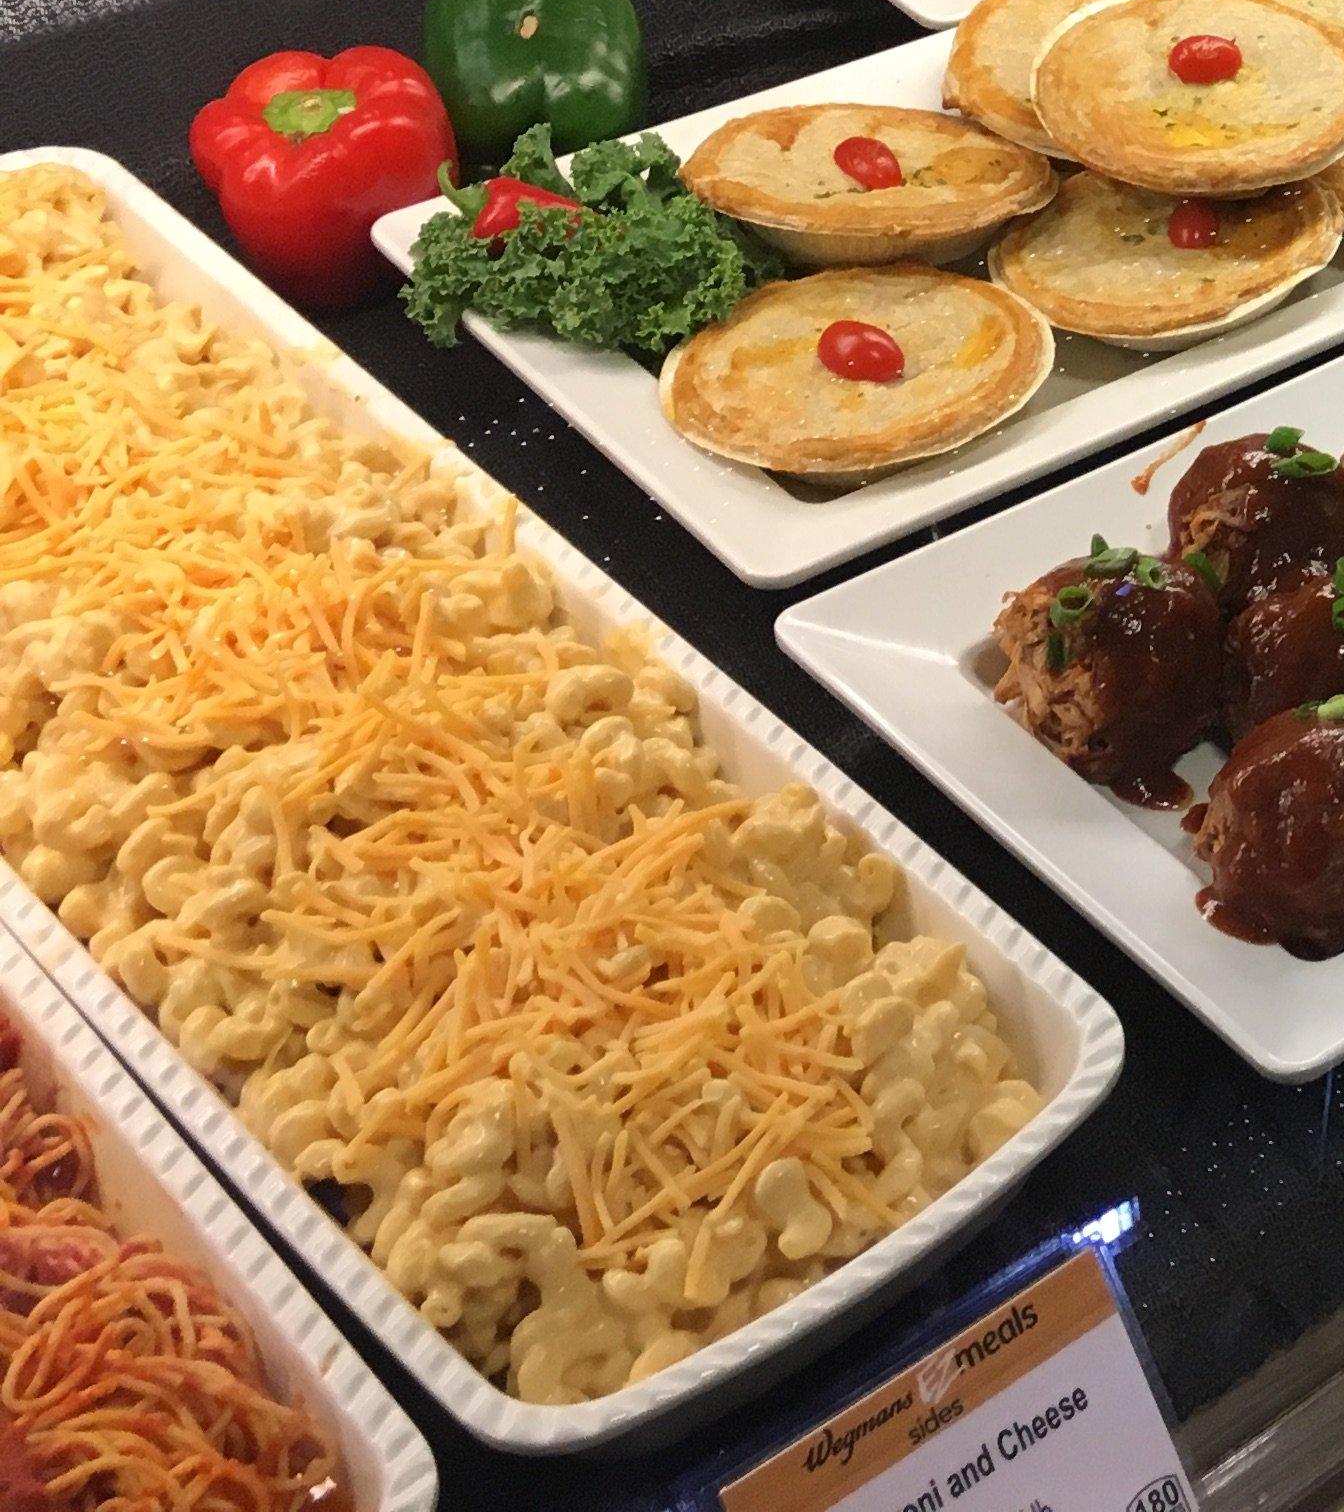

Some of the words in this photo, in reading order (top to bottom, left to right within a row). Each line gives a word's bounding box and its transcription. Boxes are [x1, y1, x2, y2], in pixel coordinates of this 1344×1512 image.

[801, 1391, 913, 1473] Wegmans
[908, 1398, 964, 1446] sides
[947, 1443, 995, 1498] and
[997, 1388, 1088, 1461] Cheese
